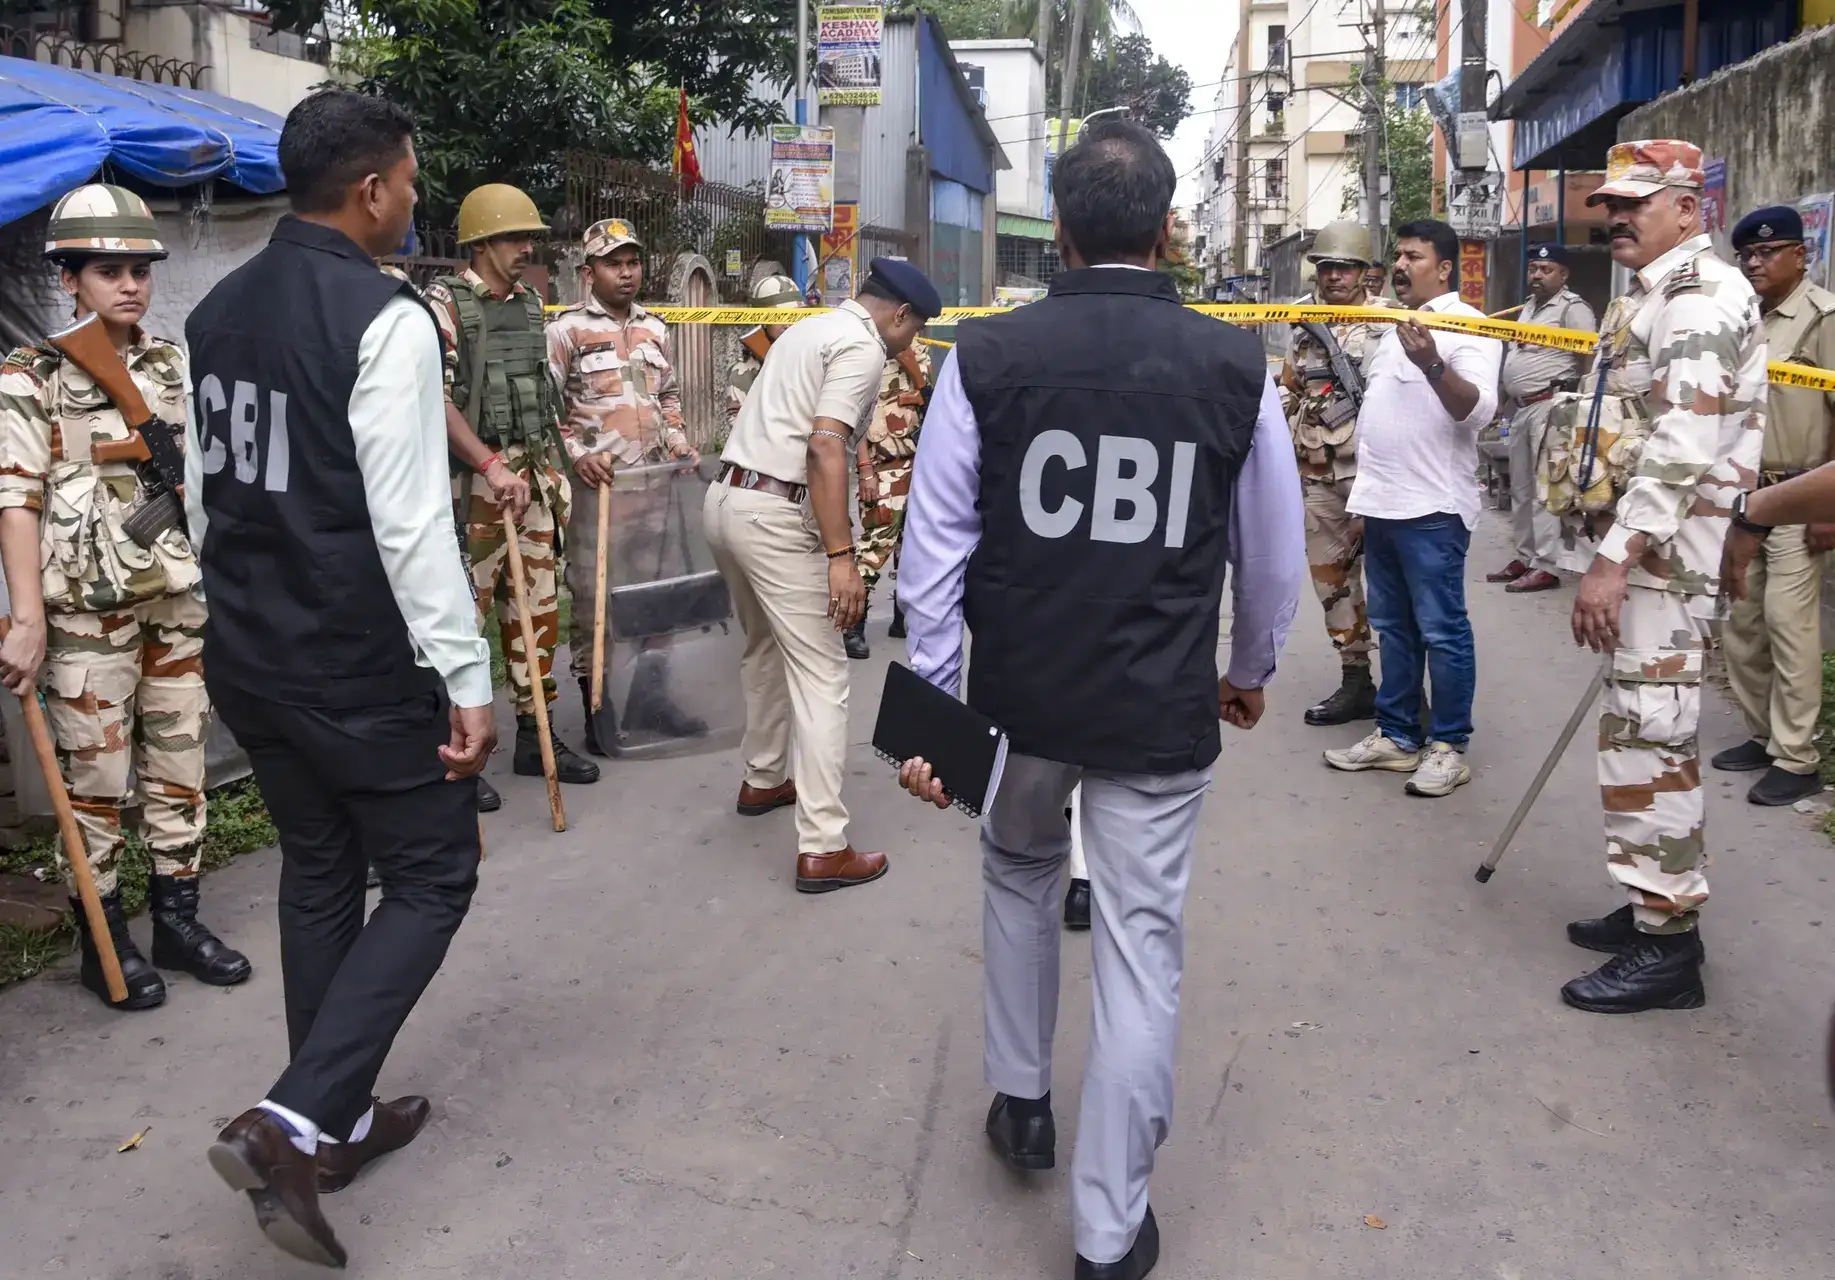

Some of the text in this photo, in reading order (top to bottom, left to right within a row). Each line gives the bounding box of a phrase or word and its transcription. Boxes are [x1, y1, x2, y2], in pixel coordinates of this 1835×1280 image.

[821, 20, 879, 29] KESHAV
[820, 28, 880, 37] ACADEMY
[1791, 373, 1826, 388] POLICE
[199, 373, 290, 493] CBI
[1019, 429, 1197, 548] CBI
